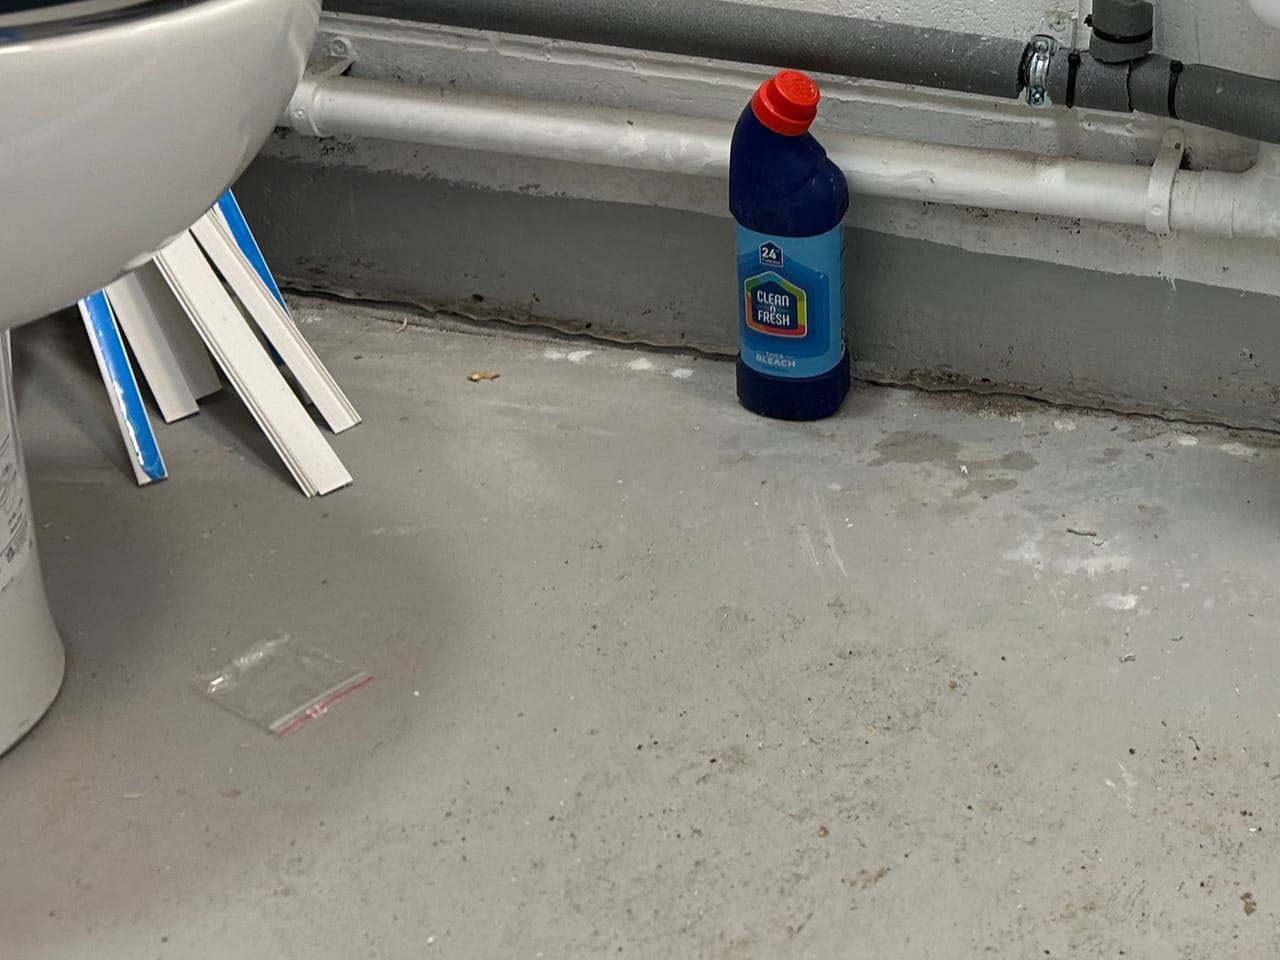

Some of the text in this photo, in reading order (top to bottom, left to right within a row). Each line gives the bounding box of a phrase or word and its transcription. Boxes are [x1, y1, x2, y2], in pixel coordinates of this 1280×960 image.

[761, 246, 777, 260] 24
[757, 289, 790, 307] CLEAN
[757, 309, 790, 327] FRESH
[756, 353, 796, 368] BLEACH
